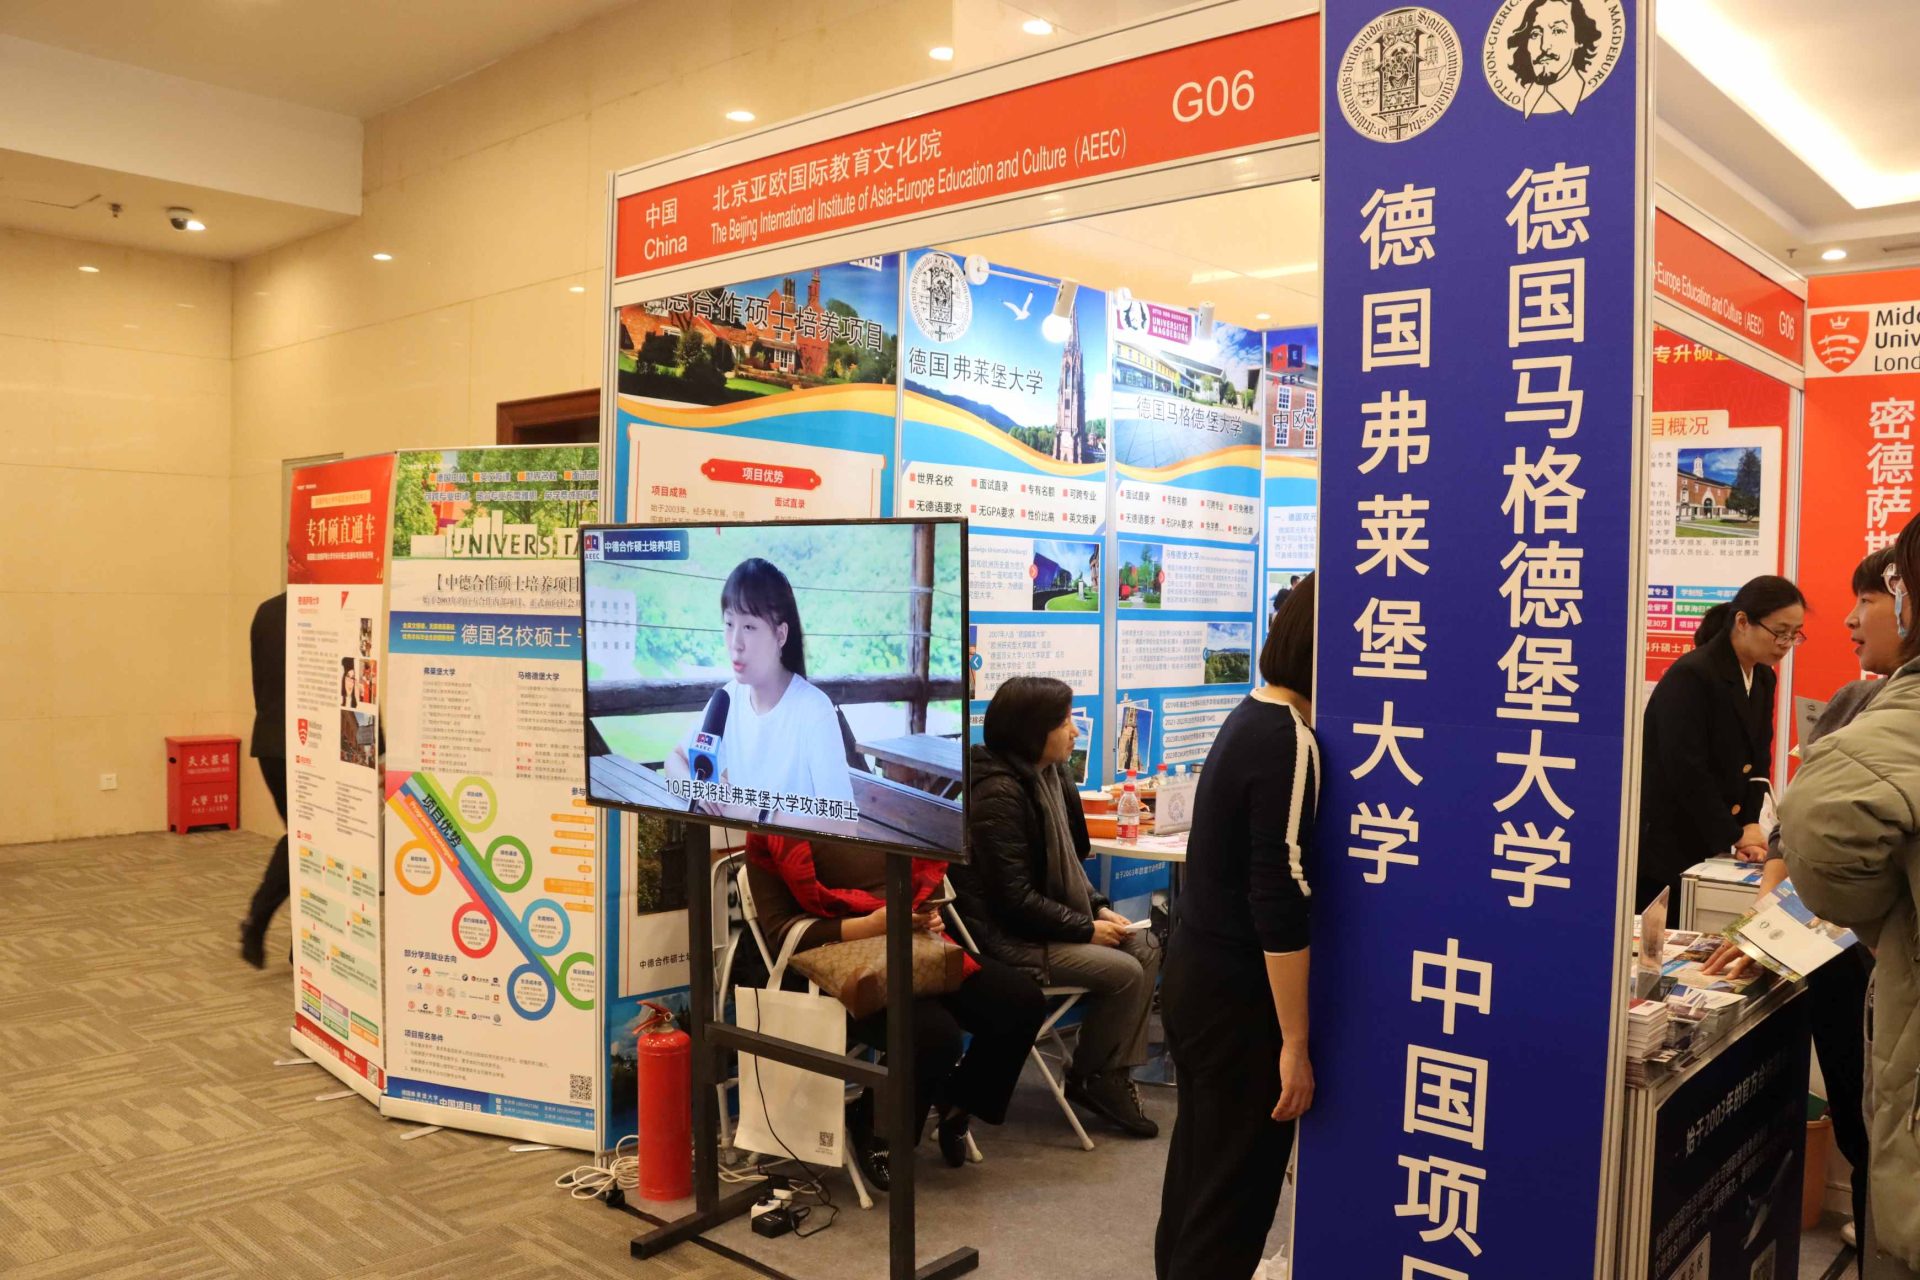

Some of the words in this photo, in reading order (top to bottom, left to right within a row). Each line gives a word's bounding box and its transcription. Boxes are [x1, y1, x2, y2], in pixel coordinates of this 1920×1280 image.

[1171, 69, 1256, 123] G06
[712, 128, 943, 212] 北京亚欧国际教育文化院
[711, 220, 728, 246] The
[728, 215, 758, 244] Beijing
[759, 202, 816, 231] International
[817, 192, 856, 221] Institute
[857, 189, 868, 212] of
[870, 175, 936, 207] Asia-Europe
[938, 160, 994, 194] Education
[996, 151, 1020, 180] and
[1022, 144, 1067, 176] Culture
[645, 197, 678, 230] 中国
[643, 232, 688, 261] China
[1681, 273, 1713, 310] Education
[1711, 296, 1725, 315] and
[1723, 303, 1743, 327] Culture
[1778, 309, 1795, 342] G06
[908, 346, 1044, 396] 德国弗莱堡大学
[1271, 373, 1305, 386] AEEC
[1136, 395, 1243, 438] 德国马格德堡大学
[1272, 408, 1318, 433] 中欧
[741, 466, 785, 484] 项目优势
[917, 472, 955, 488] 世界名校
[651, 484, 688, 499] 项目成熟
[979, 478, 1009, 493] 面试直录
[1027, 483, 1056, 498] 专有名额
[1069, 488, 1097, 501] 可跨专业
[774, 496, 806, 510] 面试直录
[915, 500, 963, 515] 无德语要求
[978, 503, 1016, 519] 无GPA要求
[1027, 509, 1056, 523] 性价比高
[1068, 512, 1097, 526] 英文授课
[306, 512, 376, 547] 专升硕直通车
[1347, 183, 1436, 884] 德国弗莱堡大学
[1490, 161, 1590, 909] 德国马格德堡大学
[604, 540, 681, 553] 中德合作硕士培养项目
[461, 623, 573, 648] 德国名校硕士
[423, 666, 456, 677] 弗莱堡大学
[517, 670, 561, 682] 马格德堡大学
[664, 778, 860, 822] 10月我将赴弗莱堡大学攻读硕士
[421, 792, 463, 849] 项目优势
[403, 948, 458, 964] 部分学员就业去向
[404, 1028, 444, 1043] 项目报名条件
